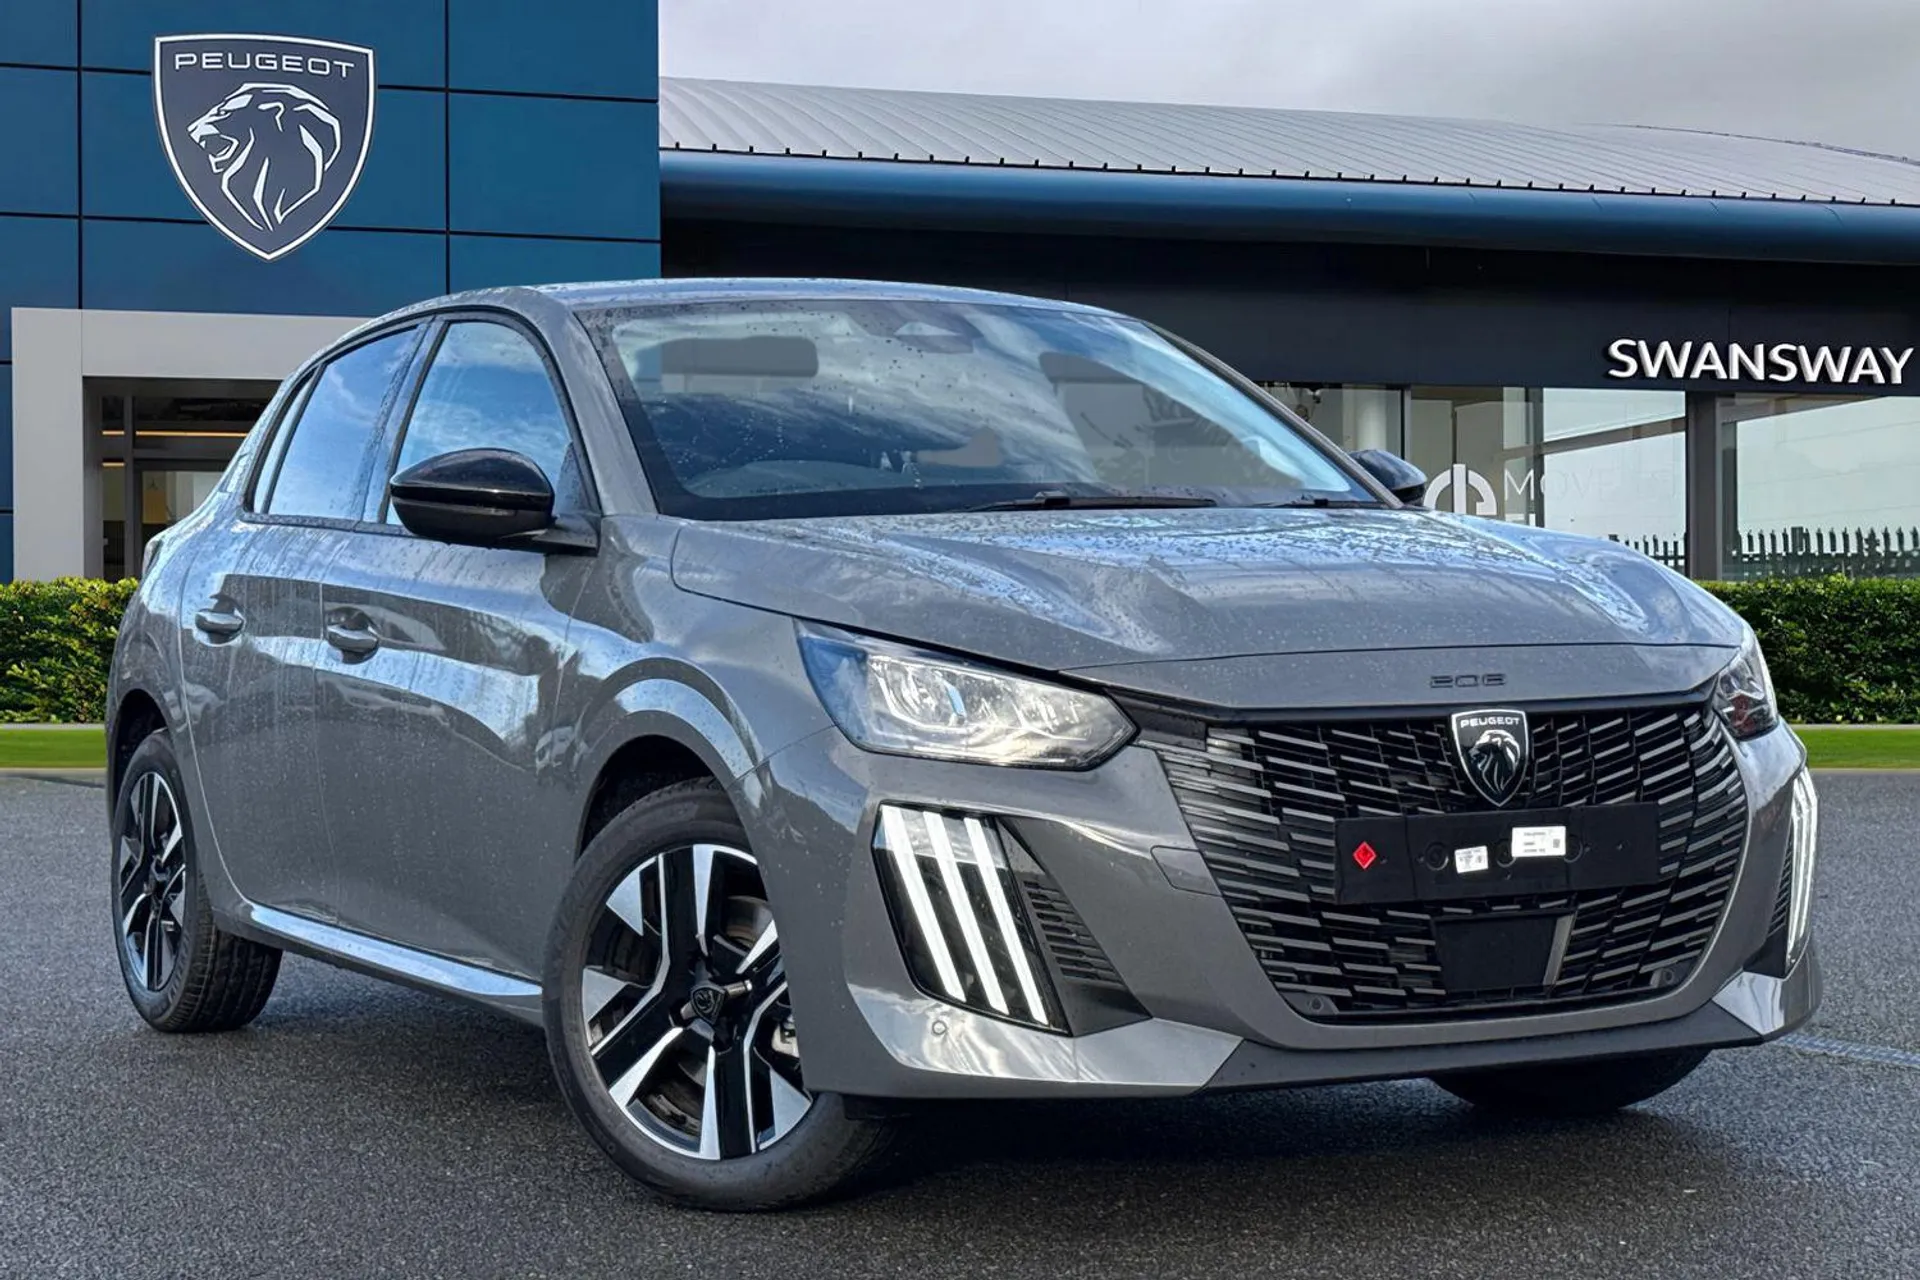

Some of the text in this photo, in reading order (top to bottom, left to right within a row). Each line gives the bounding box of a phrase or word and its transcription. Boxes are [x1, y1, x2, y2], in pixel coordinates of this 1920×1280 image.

[175, 52, 355, 78] PEUGEOT
[1608, 338, 1914, 385] SWANSWAY
[1460, 716, 1521, 729] PEUGEOT
